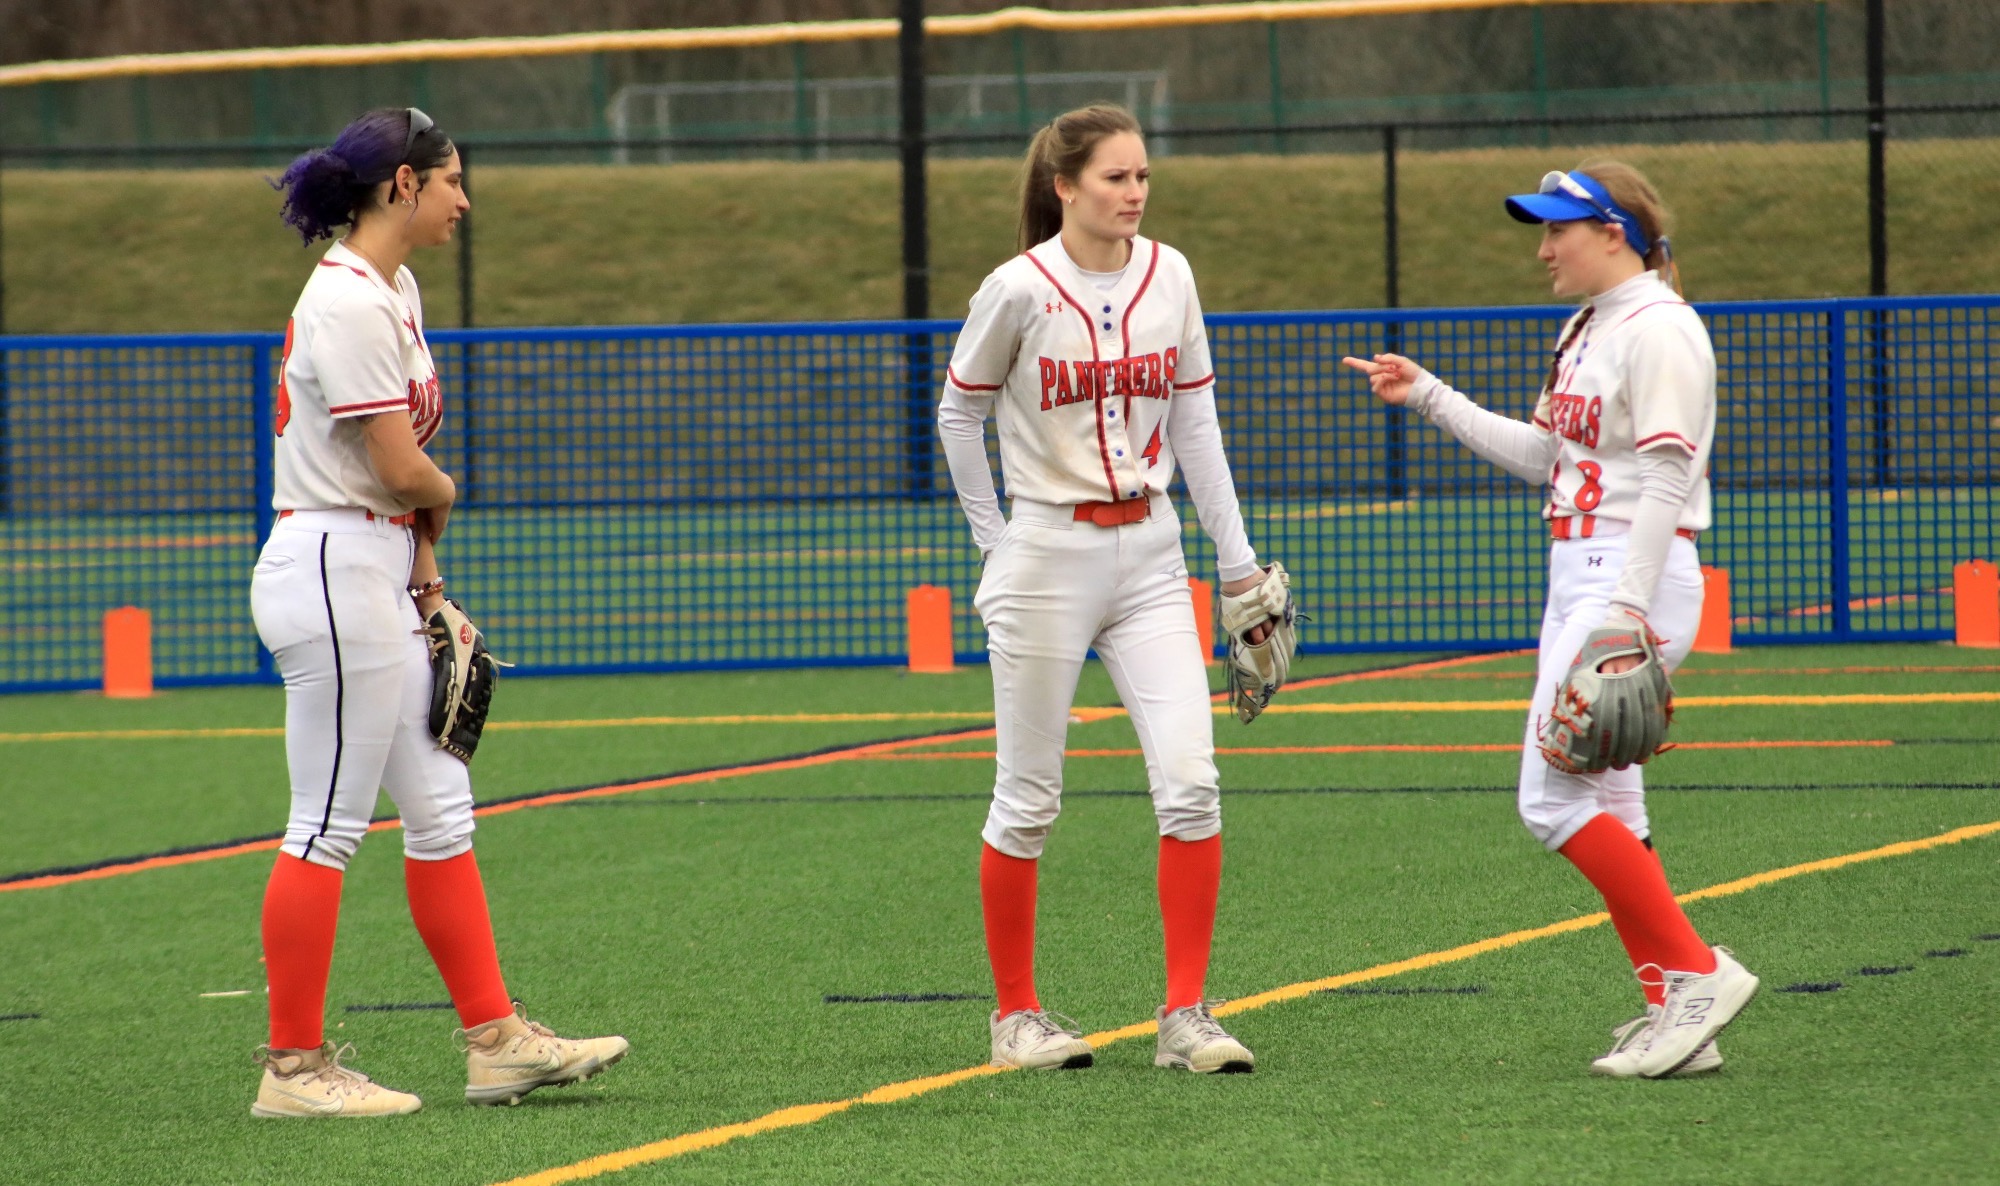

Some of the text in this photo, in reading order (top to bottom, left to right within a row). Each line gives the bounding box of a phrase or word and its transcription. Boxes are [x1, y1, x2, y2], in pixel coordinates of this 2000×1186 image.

[1039, 346, 1178, 411] PANTHERS
[1141, 415, 1163, 469] 4
[1574, 460, 1603, 512] 8
